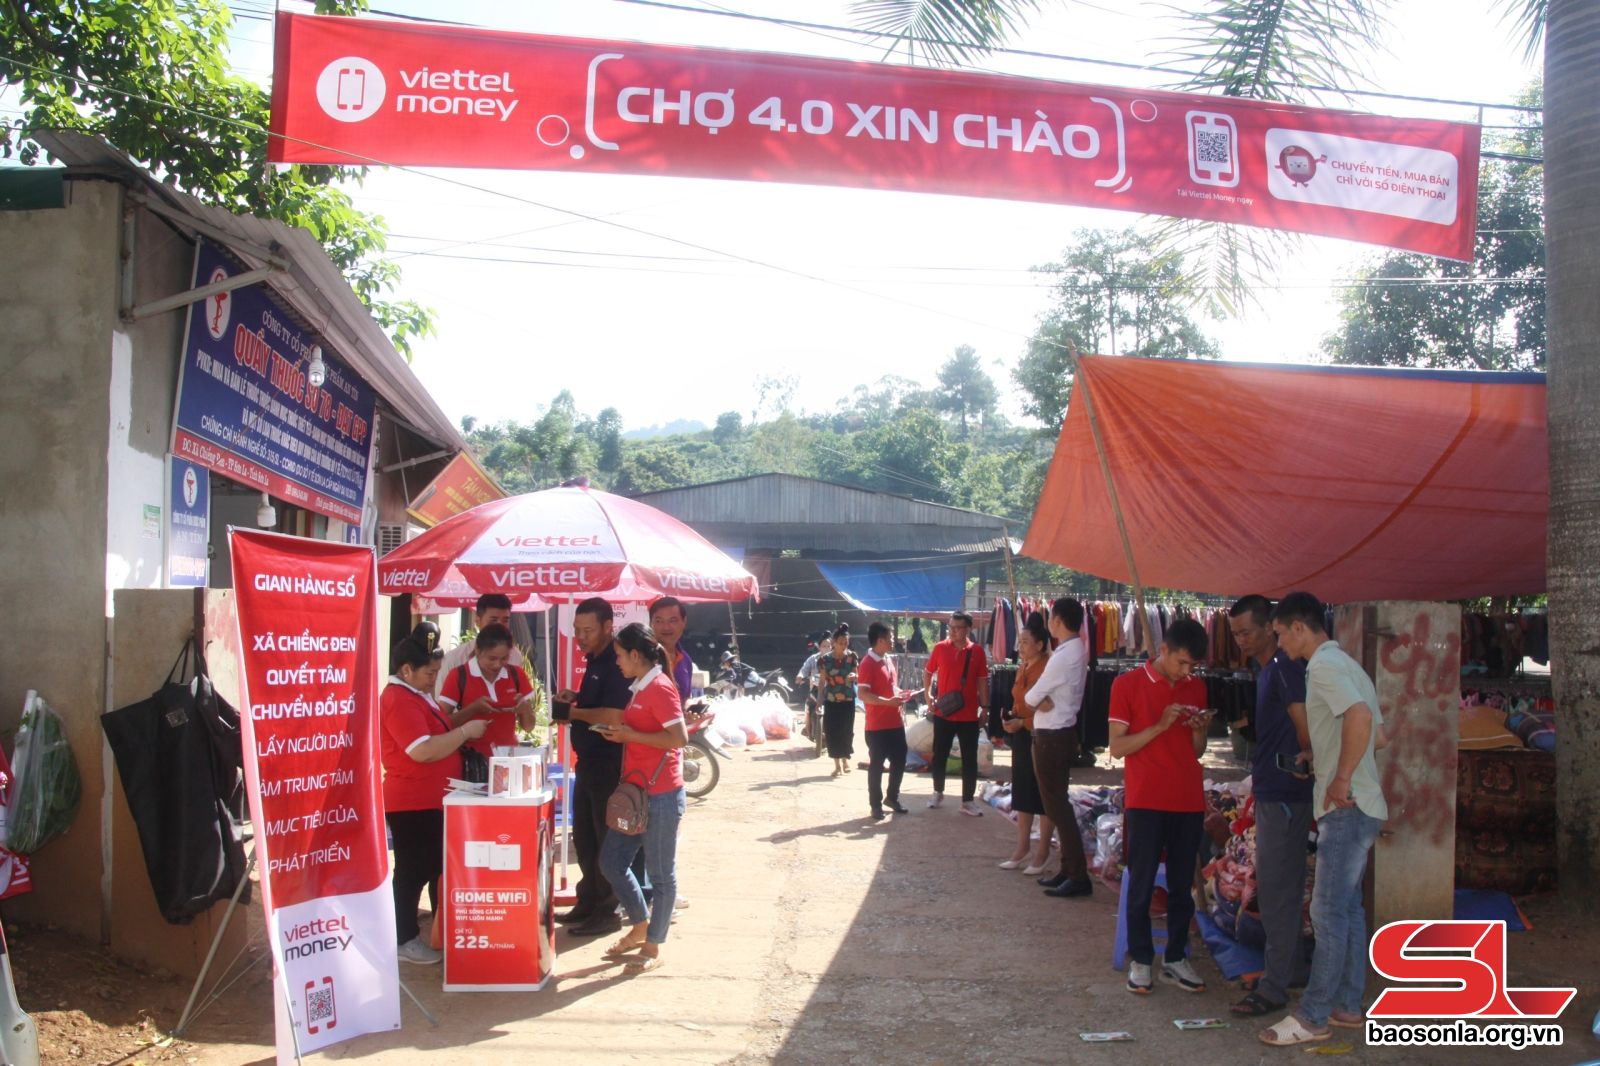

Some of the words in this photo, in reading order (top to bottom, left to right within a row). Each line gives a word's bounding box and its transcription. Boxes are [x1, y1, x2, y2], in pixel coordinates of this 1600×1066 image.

[399, 66, 515, 93] viettel
[396, 94, 519, 122] money
[616, 86, 736, 135] CHỢ
[748, 96, 834, 135] 4.0
[845, 102, 939, 144] XIN
[953, 109, 1101, 159] CHÀO
[1404, 171, 1428, 183] MUA
[1189, 190, 1212, 200] Viettel
[1212, 193, 1236, 203] Money
[262, 309, 281, 337] CÔNG
[281, 327, 291, 345] TY
[270, 348, 306, 404] THUỐC
[201, 414, 222, 437] CHỨNG
[494, 534, 602, 547] viettel
[254, 573, 292, 593] GIAN
[294, 573, 335, 596] HÀNG
[336, 574, 356, 598] SỐ
[383, 568, 431, 587] viettel
[489, 566, 591, 587] viettel
[656, 571, 730, 593] viettel
[252, 631, 276, 652] XÃ
[277, 628, 328, 652] CHIỀNG
[329, 636, 356, 652] ĐEN
[266, 660, 316, 686] QUYẾT
[317, 663, 347, 685] TÂM
[251, 693, 313, 721] CHUYỂN
[314, 692, 338, 717] ĐỔI
[339, 692, 356, 716] SỐ
[257, 733, 286, 757] LẤY
[287, 731, 327, 754] NGƯỜI
[329, 730, 353, 749] DÂN
[259, 778, 281, 798] ÀM
[284, 773, 328, 795] TRUNG
[329, 767, 354, 787] TÂM
[265, 817, 300, 837] MỤC
[301, 809, 327, 831] TIÊU
[327, 804, 359, 825] CỦA
[268, 852, 309, 876] PHÁT
[309, 840, 351, 868] TRIỂN
[454, 891, 495, 903] HOME
[496, 891, 527, 904] WIFI
[284, 915, 350, 944] viettel
[285, 933, 354, 963] money
